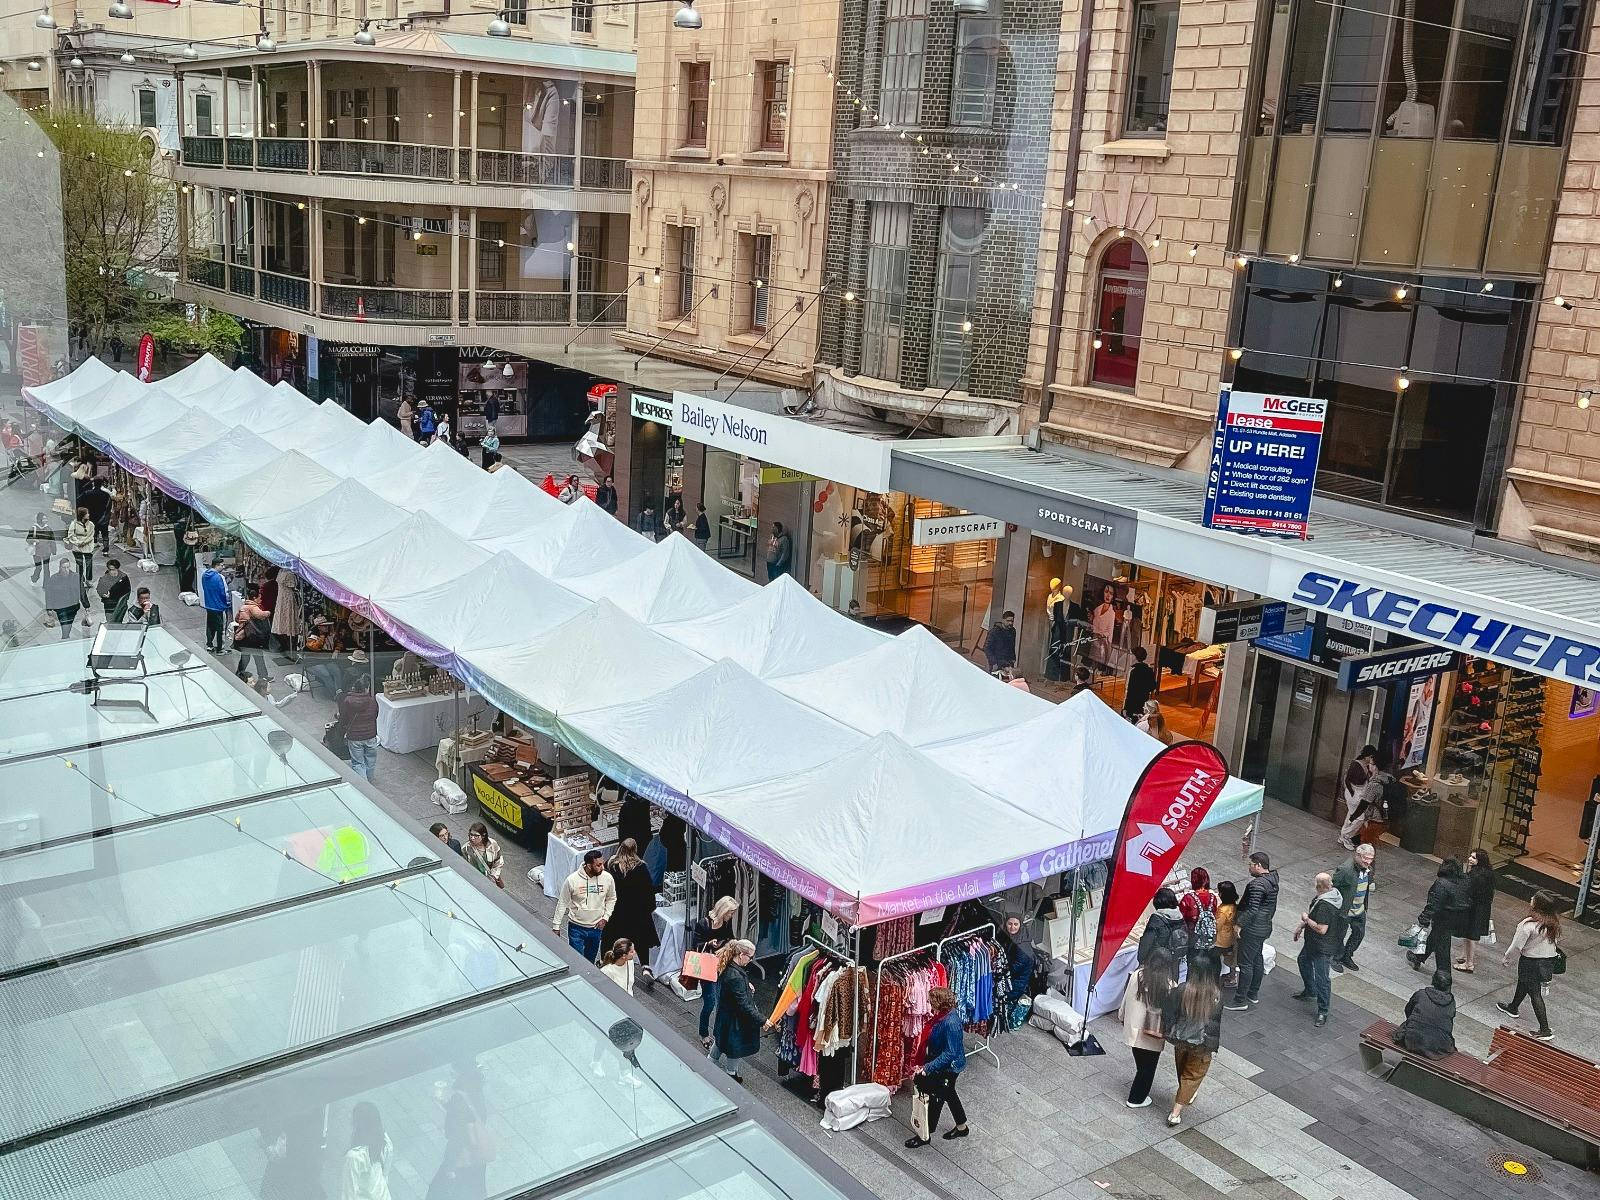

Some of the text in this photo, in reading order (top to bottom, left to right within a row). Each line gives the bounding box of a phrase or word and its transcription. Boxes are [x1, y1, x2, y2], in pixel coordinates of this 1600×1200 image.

[634, 397, 673, 421] NESPRESS
[681, 402, 768, 445] Bailey Nelson
[1233, 413, 1273, 428] lease
[1229, 439, 1306, 460] UP HERE!
[1231, 471, 1253, 480] Whole
[1254, 472, 1268, 481] floor
[1269, 474, 1276, 482] of
[1233, 461, 1293, 475] Medical consulting
[1229, 489, 1254, 499] Existing
[1268, 492, 1297, 503] dentistry
[1230, 480, 1283, 492] Direct lift access
[1038, 508, 1114, 536] SPORTSCRAFT
[1220, 505, 1303, 520] Tim Pozza 0411 41 81 61
[928, 521, 999, 536] SPORTSCRAFT
[1271, 521, 1287, 529] 8414
[1292, 571, 1600, 683] SKECHER
[1356, 651, 1453, 684] SKECHERS
[1161, 768, 1211, 831] SOUTH
[1177, 778, 1220, 834] AUSTRALIA
[877, 896, 921, 917] Market
[921, 892, 933, 908] in
[935, 888, 955, 904] the
[957, 879, 981, 898] Mall
